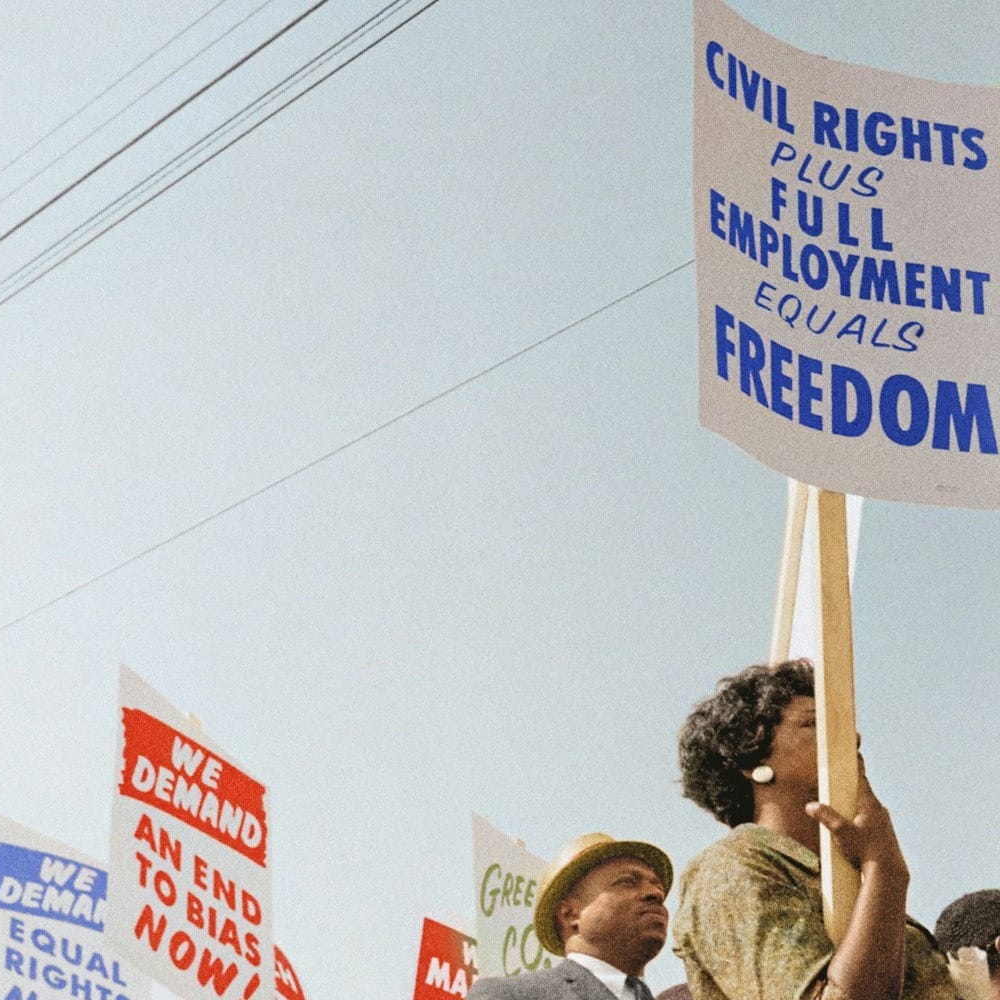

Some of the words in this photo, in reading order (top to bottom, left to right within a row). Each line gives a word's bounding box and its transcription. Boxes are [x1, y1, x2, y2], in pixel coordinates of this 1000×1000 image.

[706, 40, 795, 134] CIVIL
[814, 101, 988, 171] RIGHTS
[770, 141, 885, 198] PLUS
[771, 176, 893, 252] FULL
[710, 188, 991, 315] EMPLOYMENT
[754, 281, 925, 353] EQUALS
[715, 305, 999, 454] FREEDOM
[171, 736, 223, 789] WE
[131, 755, 262, 849] DEMAND
[39, 856, 98, 892] WE
[134, 813, 182, 872] AN
[193, 854, 262, 926] END
[481, 863, 537, 917] GREE
[135, 852, 177, 907] TO
[186, 891, 261, 968] BIAS
[9, 917, 127, 987] EQUAL
[425, 957, 479, 999] MA
